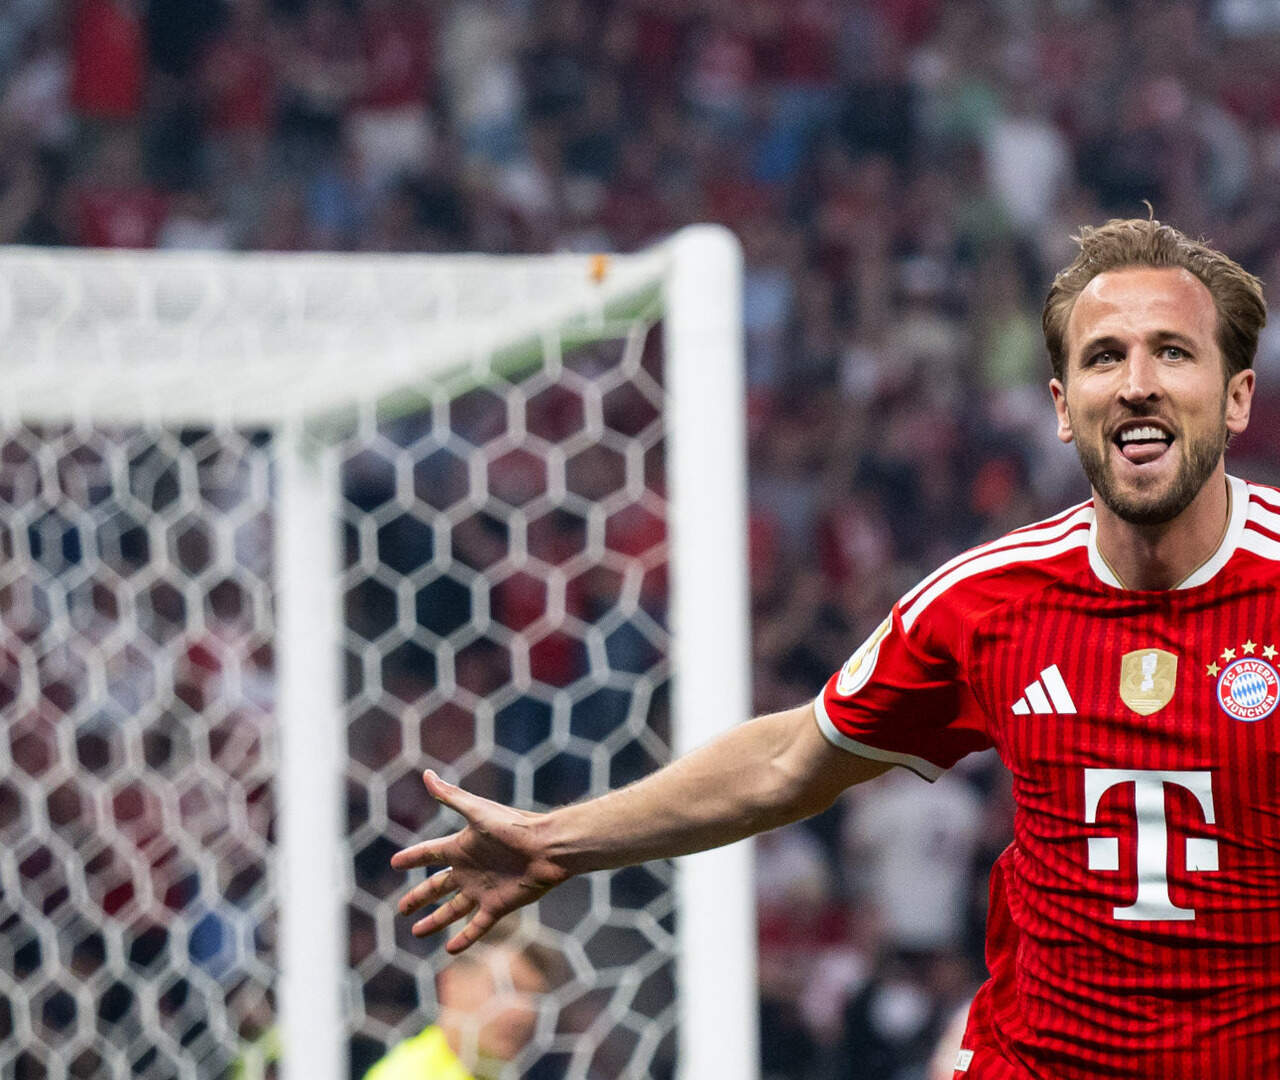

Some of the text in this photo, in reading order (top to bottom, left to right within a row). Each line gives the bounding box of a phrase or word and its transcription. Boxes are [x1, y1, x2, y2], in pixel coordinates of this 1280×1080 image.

[1222, 662, 1277, 688] FC BAYERN
[1084, 769, 1220, 921] T
